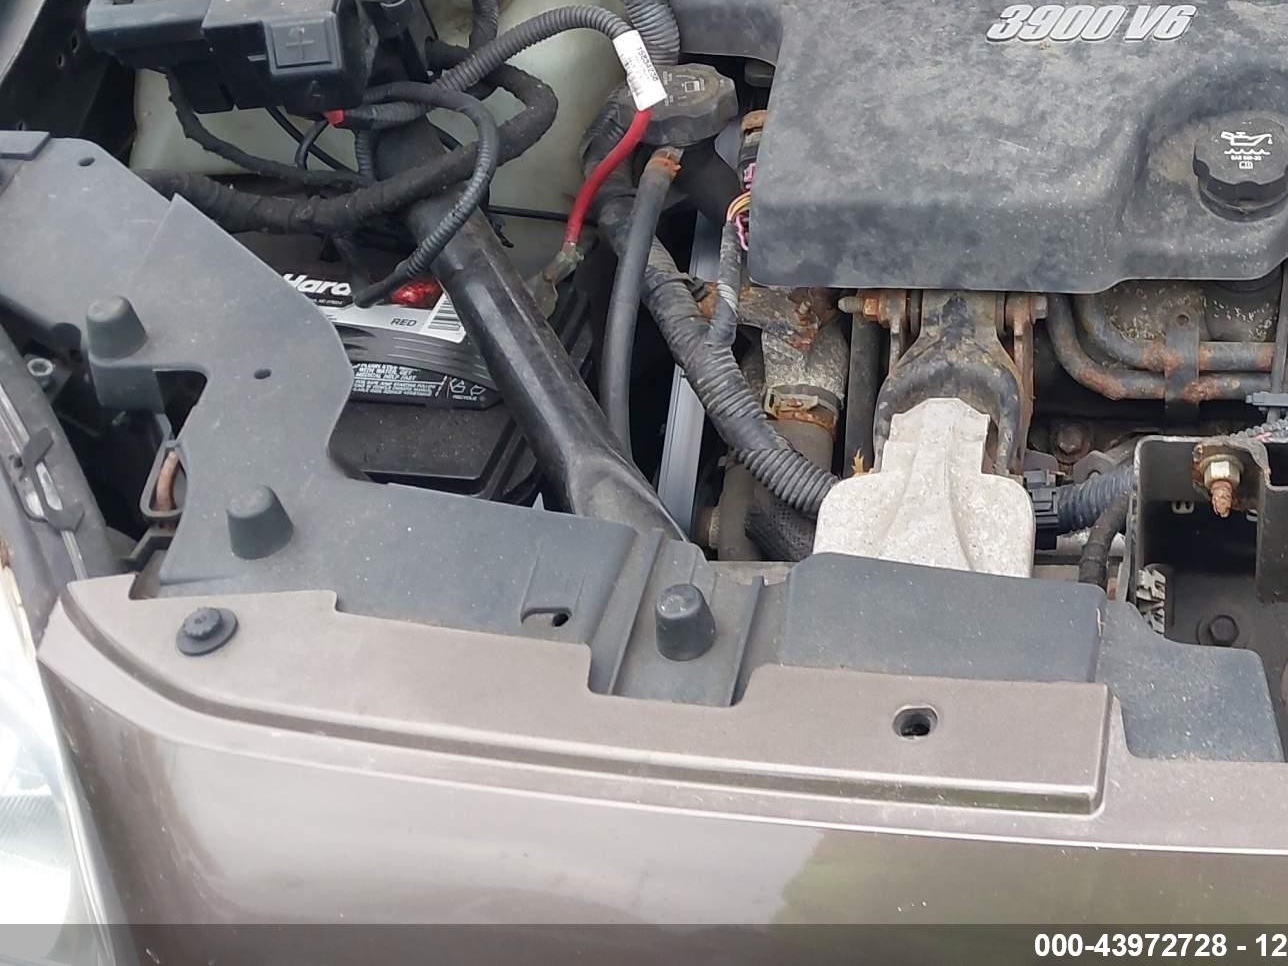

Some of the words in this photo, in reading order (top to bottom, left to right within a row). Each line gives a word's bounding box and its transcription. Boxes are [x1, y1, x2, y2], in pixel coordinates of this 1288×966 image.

[986, 4, 1128, 42] 3900
[1124, 4, 1198, 42] V6
[390, 317, 417, 328] RED
